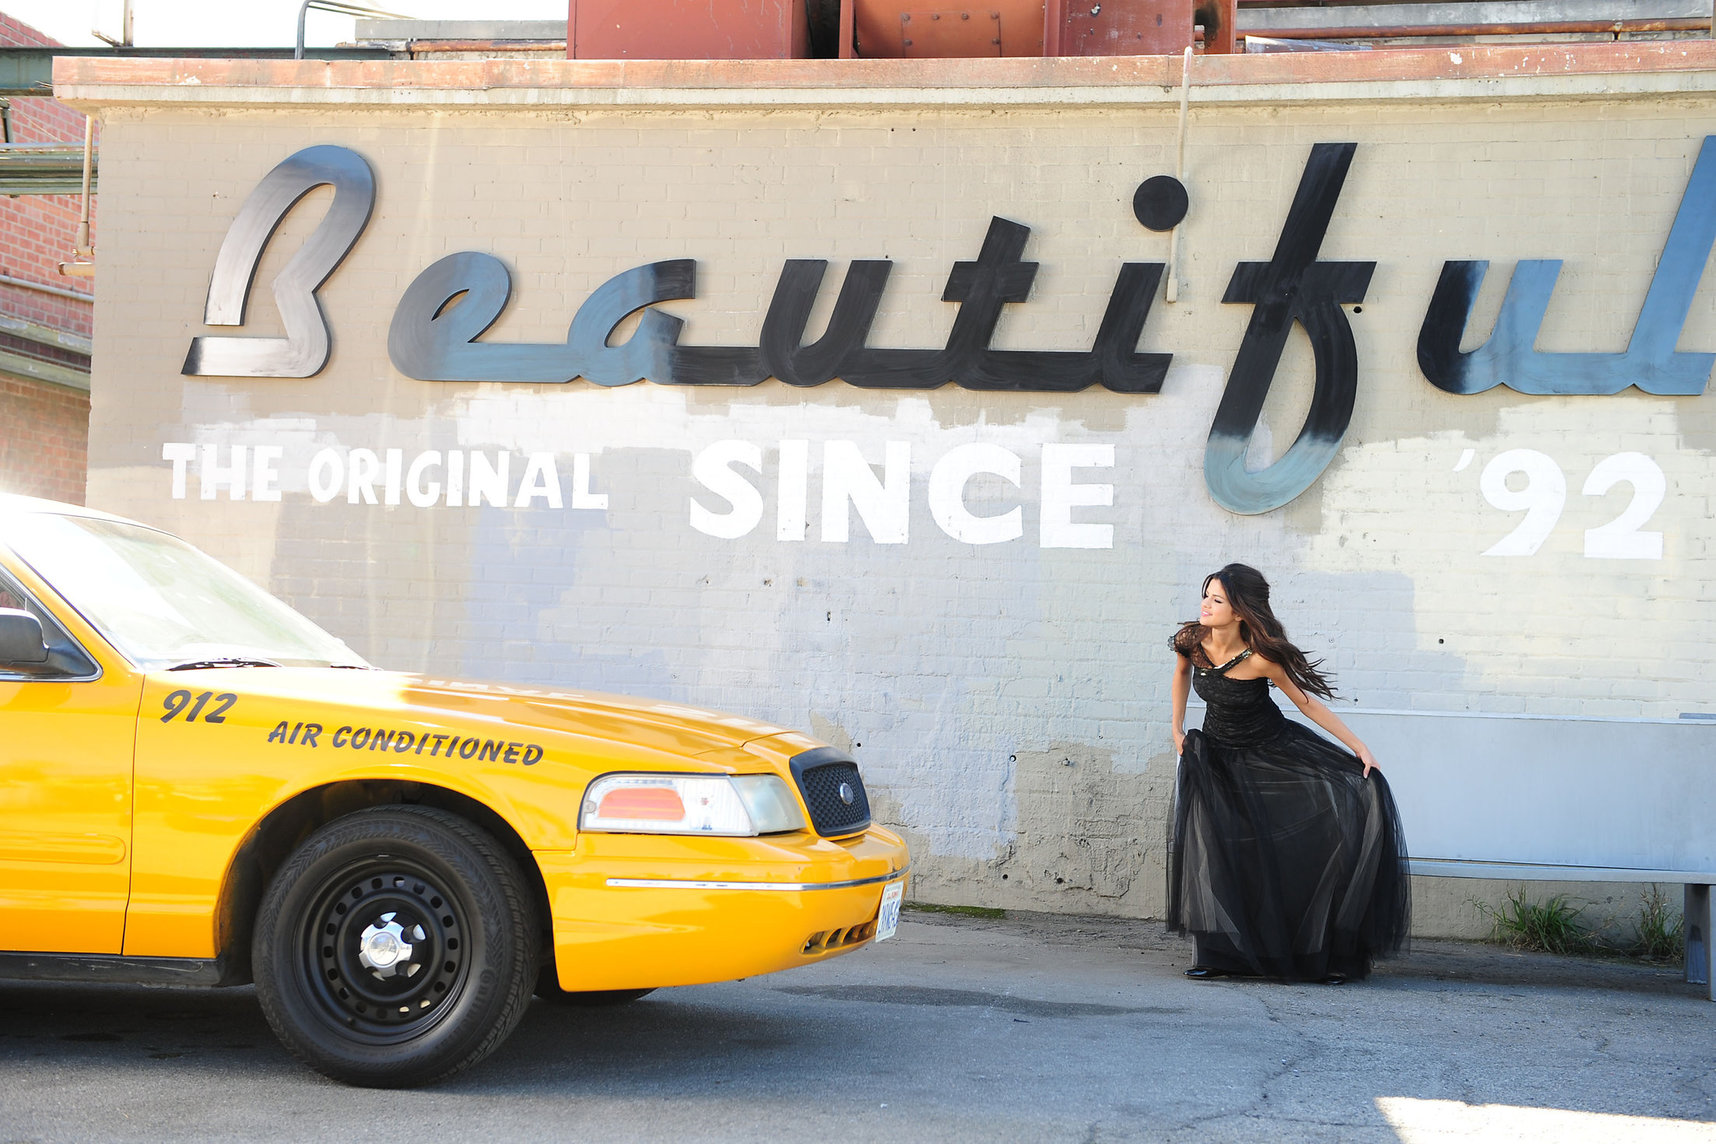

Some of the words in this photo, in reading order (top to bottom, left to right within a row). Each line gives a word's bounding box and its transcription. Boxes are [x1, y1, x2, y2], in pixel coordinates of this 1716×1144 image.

[181, 135, 1716, 515] Beautiful
[163, 442, 283, 502] THE
[308, 448, 609, 511] ORIGINAL
[689, 439, 1116, 550] SINCE
[1453, 449, 1667, 560] '92
[160, 690, 238, 724] 912
[267, 720, 323, 748] AIR
[332, 725, 544, 766] CONDITIONED
